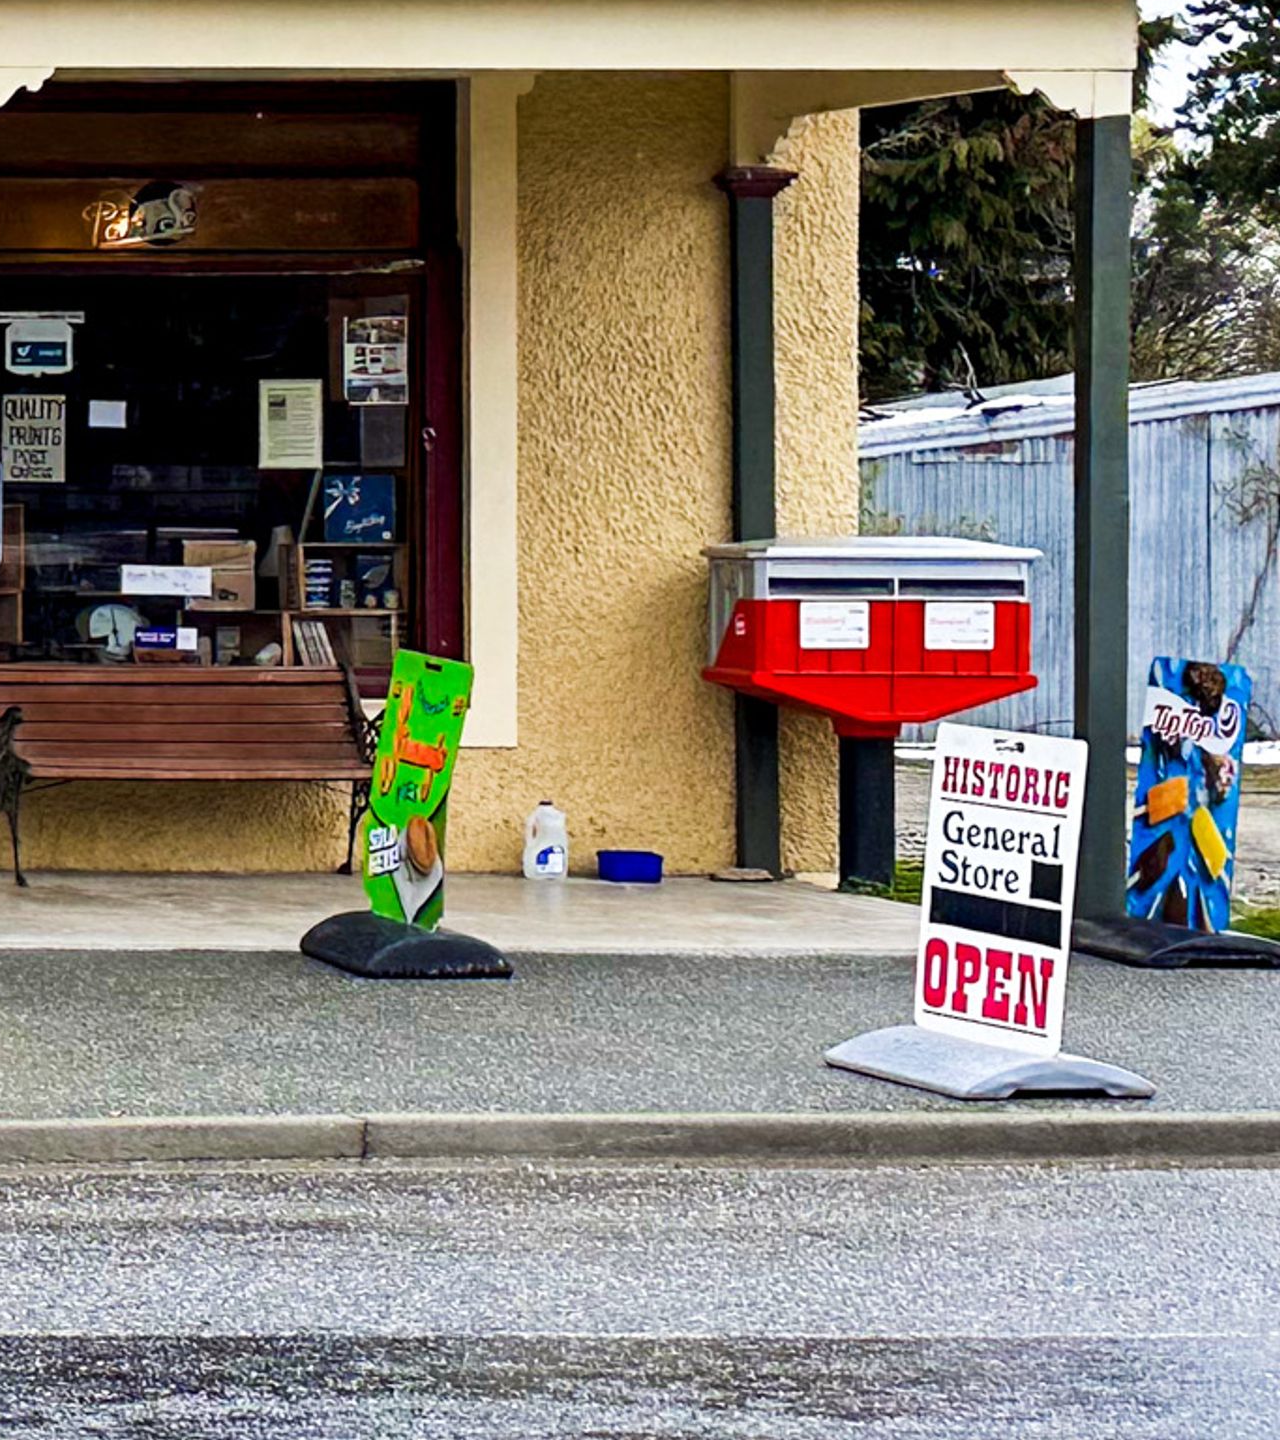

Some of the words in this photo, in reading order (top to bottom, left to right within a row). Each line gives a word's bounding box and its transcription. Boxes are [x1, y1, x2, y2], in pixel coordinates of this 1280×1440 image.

[4, 398, 65, 422] QUALITY
[941, 756, 1071, 809] HISTORIC
[942, 810, 1061, 860] General
[938, 849, 1020, 894] Store
[922, 937, 1055, 1030] OPEN
